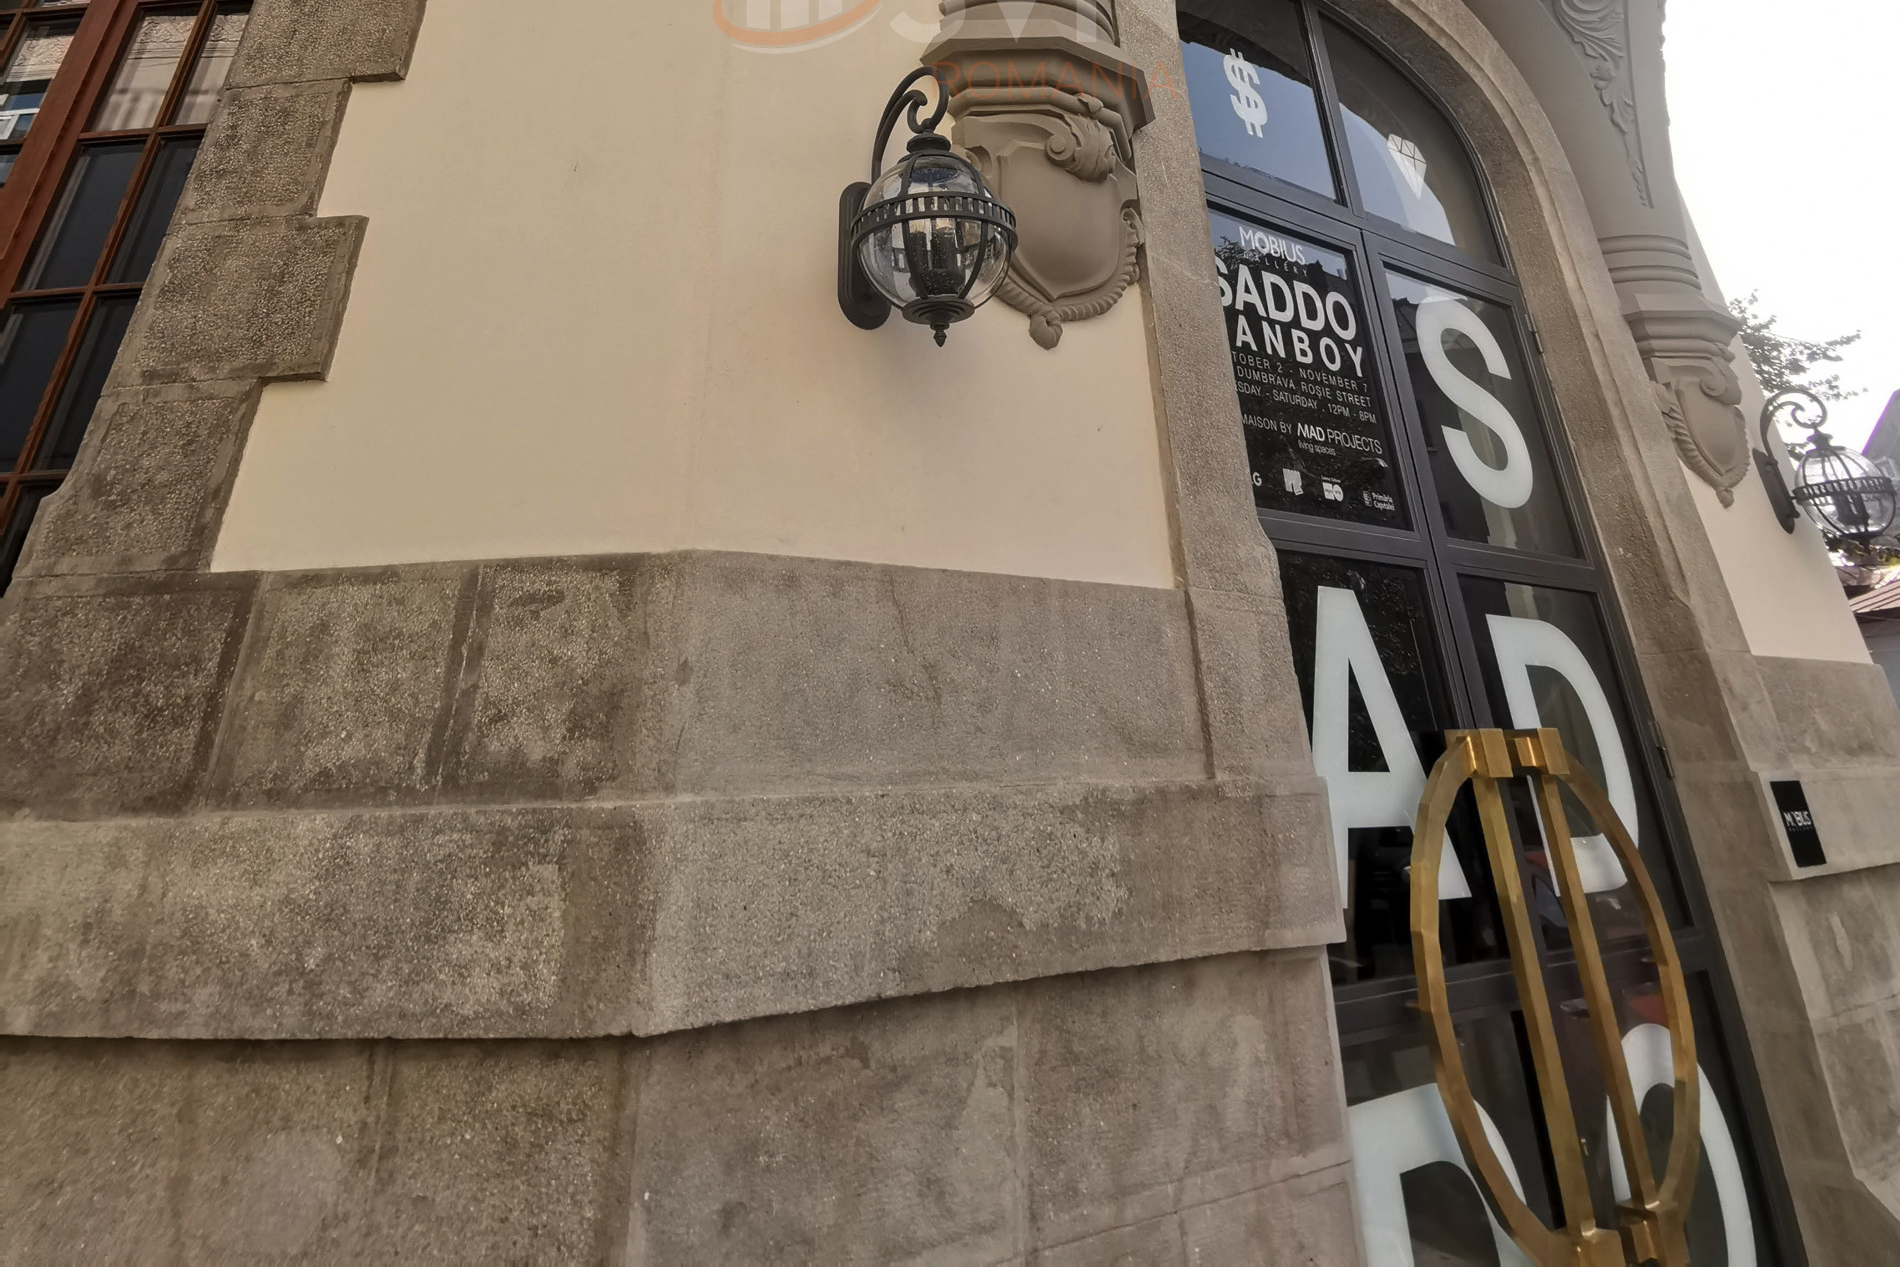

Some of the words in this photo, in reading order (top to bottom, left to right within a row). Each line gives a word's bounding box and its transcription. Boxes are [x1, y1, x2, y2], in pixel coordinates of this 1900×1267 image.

[1239, 226, 1306, 265] MOBIUS
[1237, 366, 1296, 389] DUMBRAVA
[1336, 391, 1371, 407] STREET
[1276, 361, 1283, 373] 2
[1299, 367, 1358, 390] NOVEMBER
[1362, 383, 1368, 394] 7
[1273, 389, 1318, 410] SATURDAY
[1327, 403, 1350, 418] 12PM
[1359, 411, 1377, 424] 8PM
[1417, 301, 1532, 508] S
[1280, 421, 1292, 434] BY
[1297, 422, 1326, 442] MAD
[1327, 429, 1383, 454] PROJECTS
